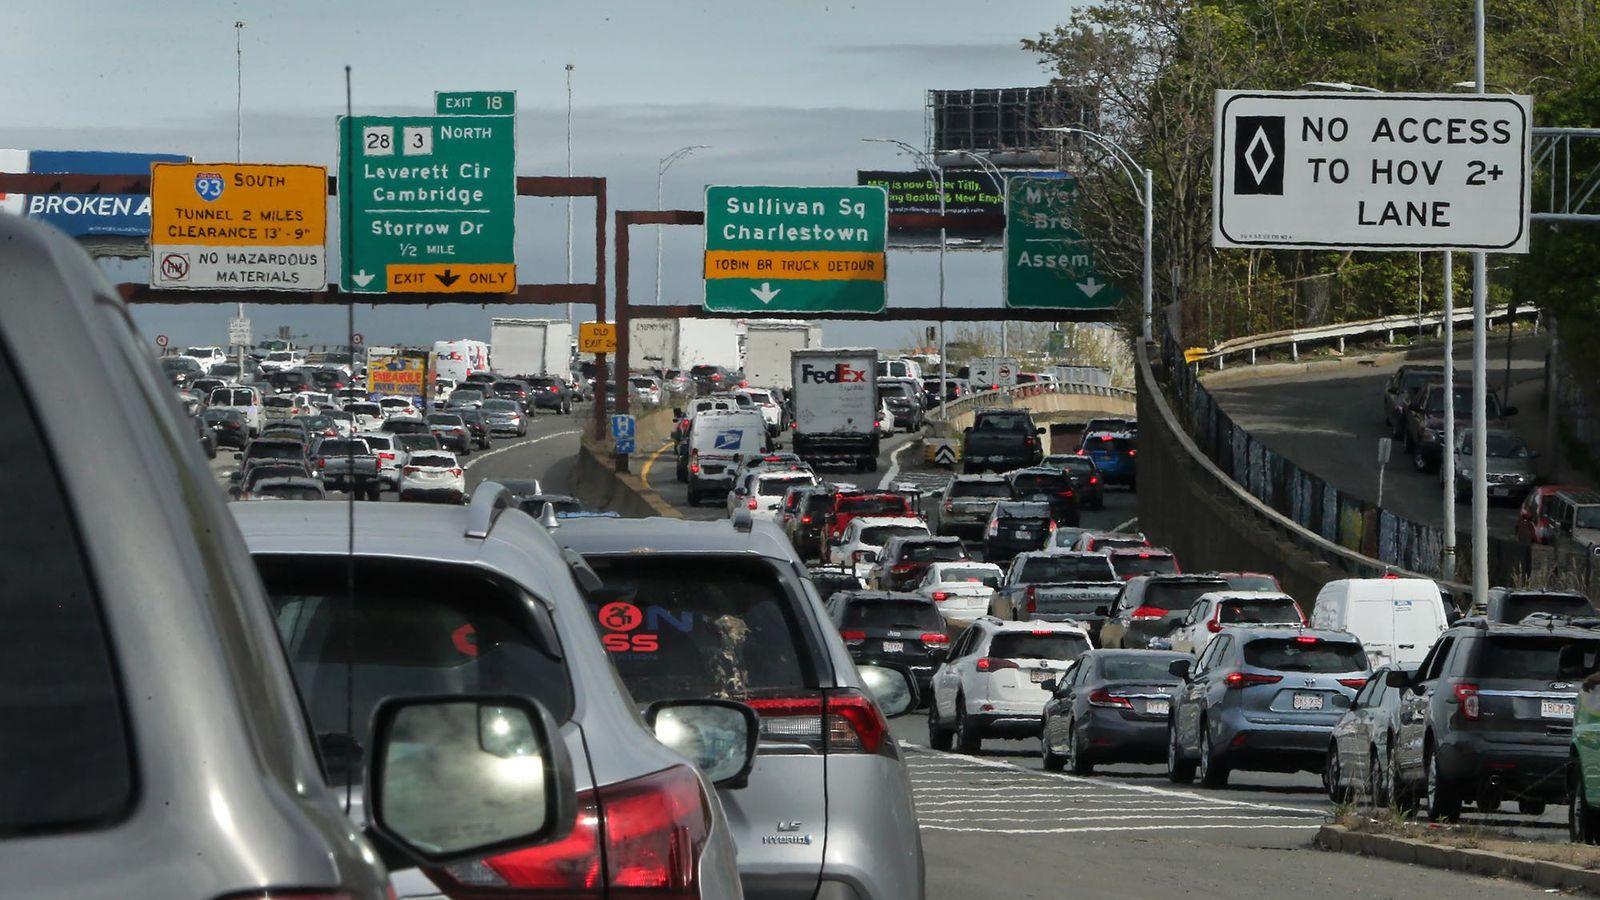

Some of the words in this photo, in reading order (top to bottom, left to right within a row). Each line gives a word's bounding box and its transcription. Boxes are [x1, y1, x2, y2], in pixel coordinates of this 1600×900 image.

[446, 97, 472, 108] EXIT
[486, 96, 503, 109] 18
[366, 133, 391, 149] 28
[413, 133, 424, 149] 3
[441, 126, 492, 140] NORTH
[1302, 116, 1349, 142] NO
[1371, 117, 1511, 145] ACCESS
[364, 163, 449, 179] Leverett
[459, 163, 491, 179] Cir
[1307, 157, 1350, 184] TO
[1371, 158, 1443, 185] HOV
[1466, 160, 1504, 185] 2+
[198, 179, 221, 196] 93
[234, 173, 285, 187] SOUTH
[373, 186, 483, 205] Cambridge
[905, 193, 940, 202] Boston
[955, 193, 976, 202] New
[29, 195, 132, 216] BROKEN
[726, 197, 825, 216] Sullivan
[839, 198, 866, 220] Sq
[175, 208, 232, 221] TUNNEL
[243, 210, 252, 221] 2
[260, 209, 304, 222] MILES
[1358, 200, 1451, 227] LANE
[168, 226, 257, 239] CLEARANCE
[372, 220, 449, 235] Storrow
[460, 220, 484, 235] Dr
[723, 223, 869, 241] Charlestown
[427, 245, 455, 255] MILE
[199, 252, 219, 265] NO
[227, 252, 318, 266] HAZARDOUS
[714, 259, 749, 270] TOBIN
[757, 259, 772, 270] BR
[782, 260, 820, 271] TRUCK
[827, 259, 875, 271] DETOUR
[216, 270, 300, 284] MATERIALS
[394, 273, 426, 284] EXIT
[469, 272, 507, 284] ONLY
[584, 338, 601, 348] EXIT
[801, 363, 867, 384] FedEx
[762, 835, 806, 845] HYBRID
